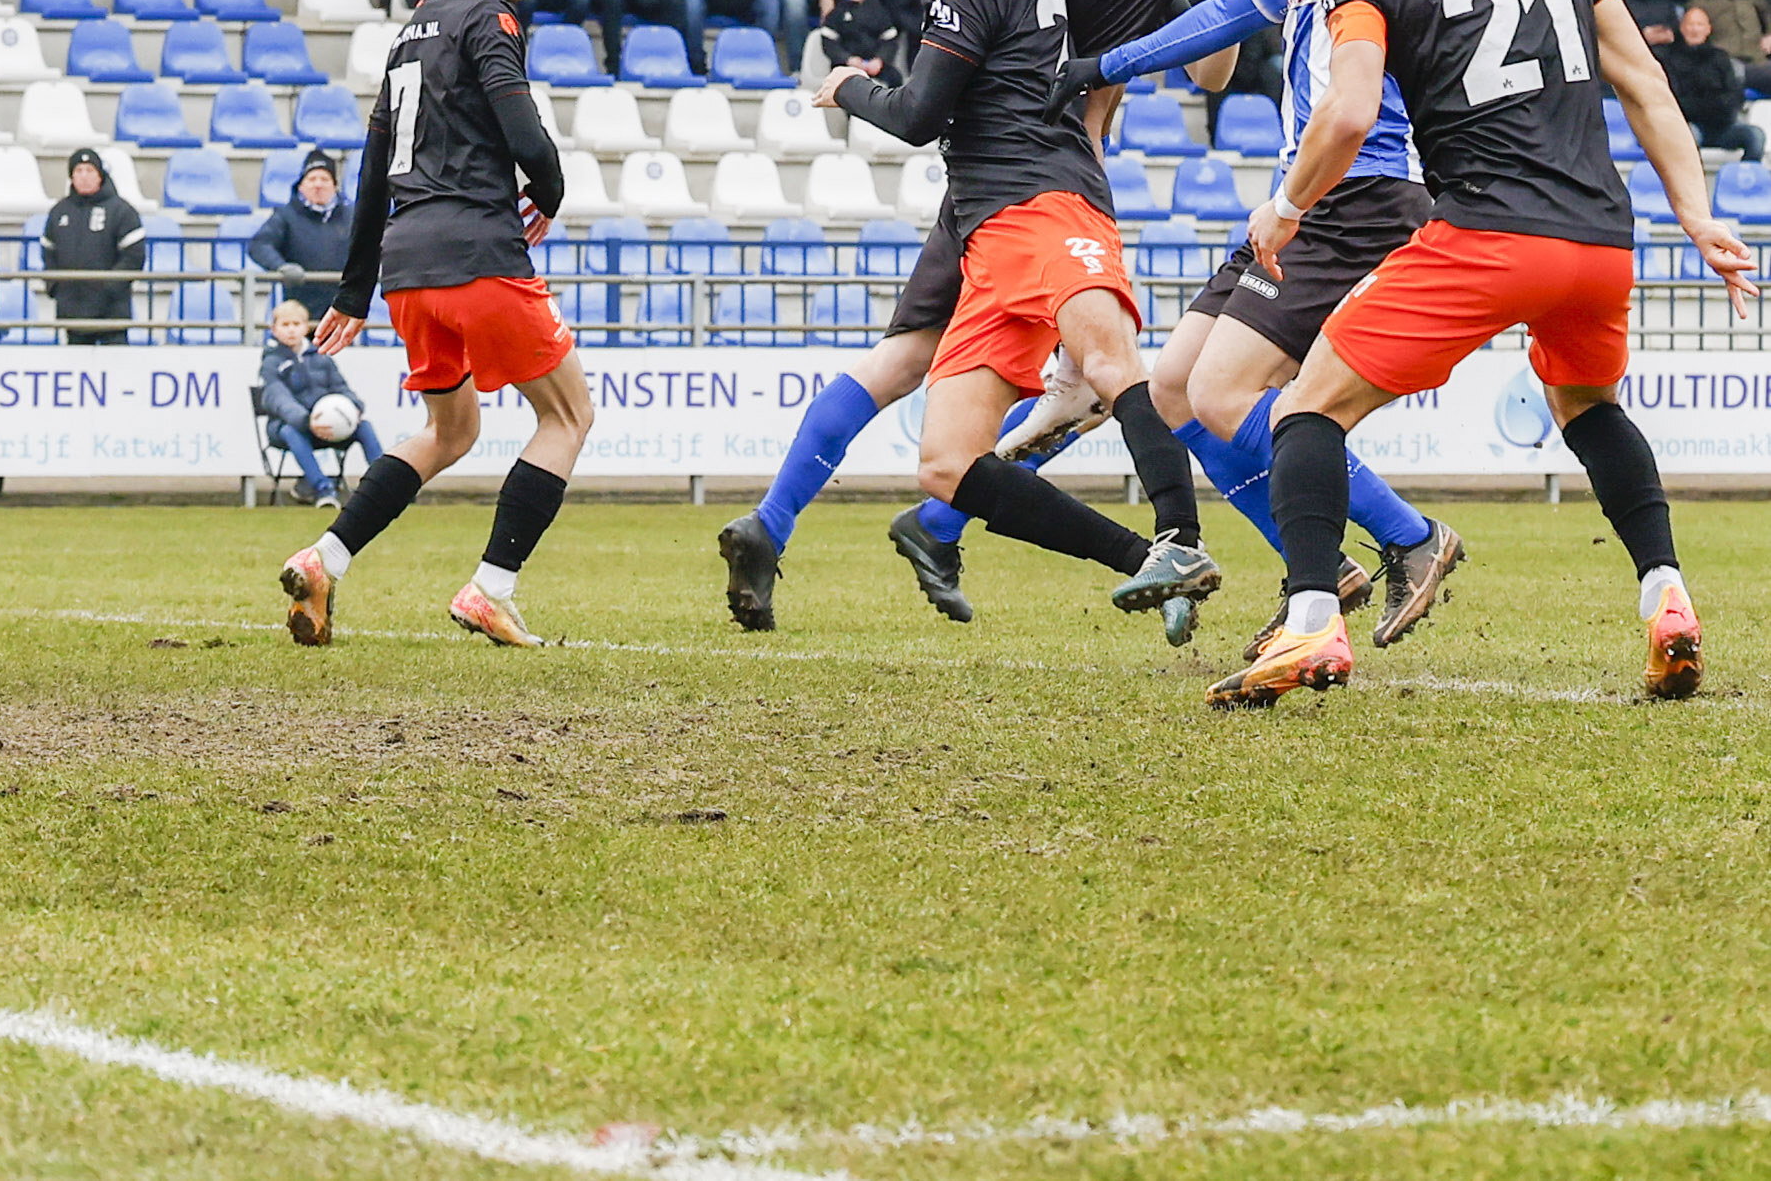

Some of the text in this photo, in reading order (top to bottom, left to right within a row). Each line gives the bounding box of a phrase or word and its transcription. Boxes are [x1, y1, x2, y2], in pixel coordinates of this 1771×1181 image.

[387, 60, 422, 177] 7
[1065, 237, 1106, 258] 22
[151, 371, 222, 408] DM
[94, 432, 223, 465] Katwijk
